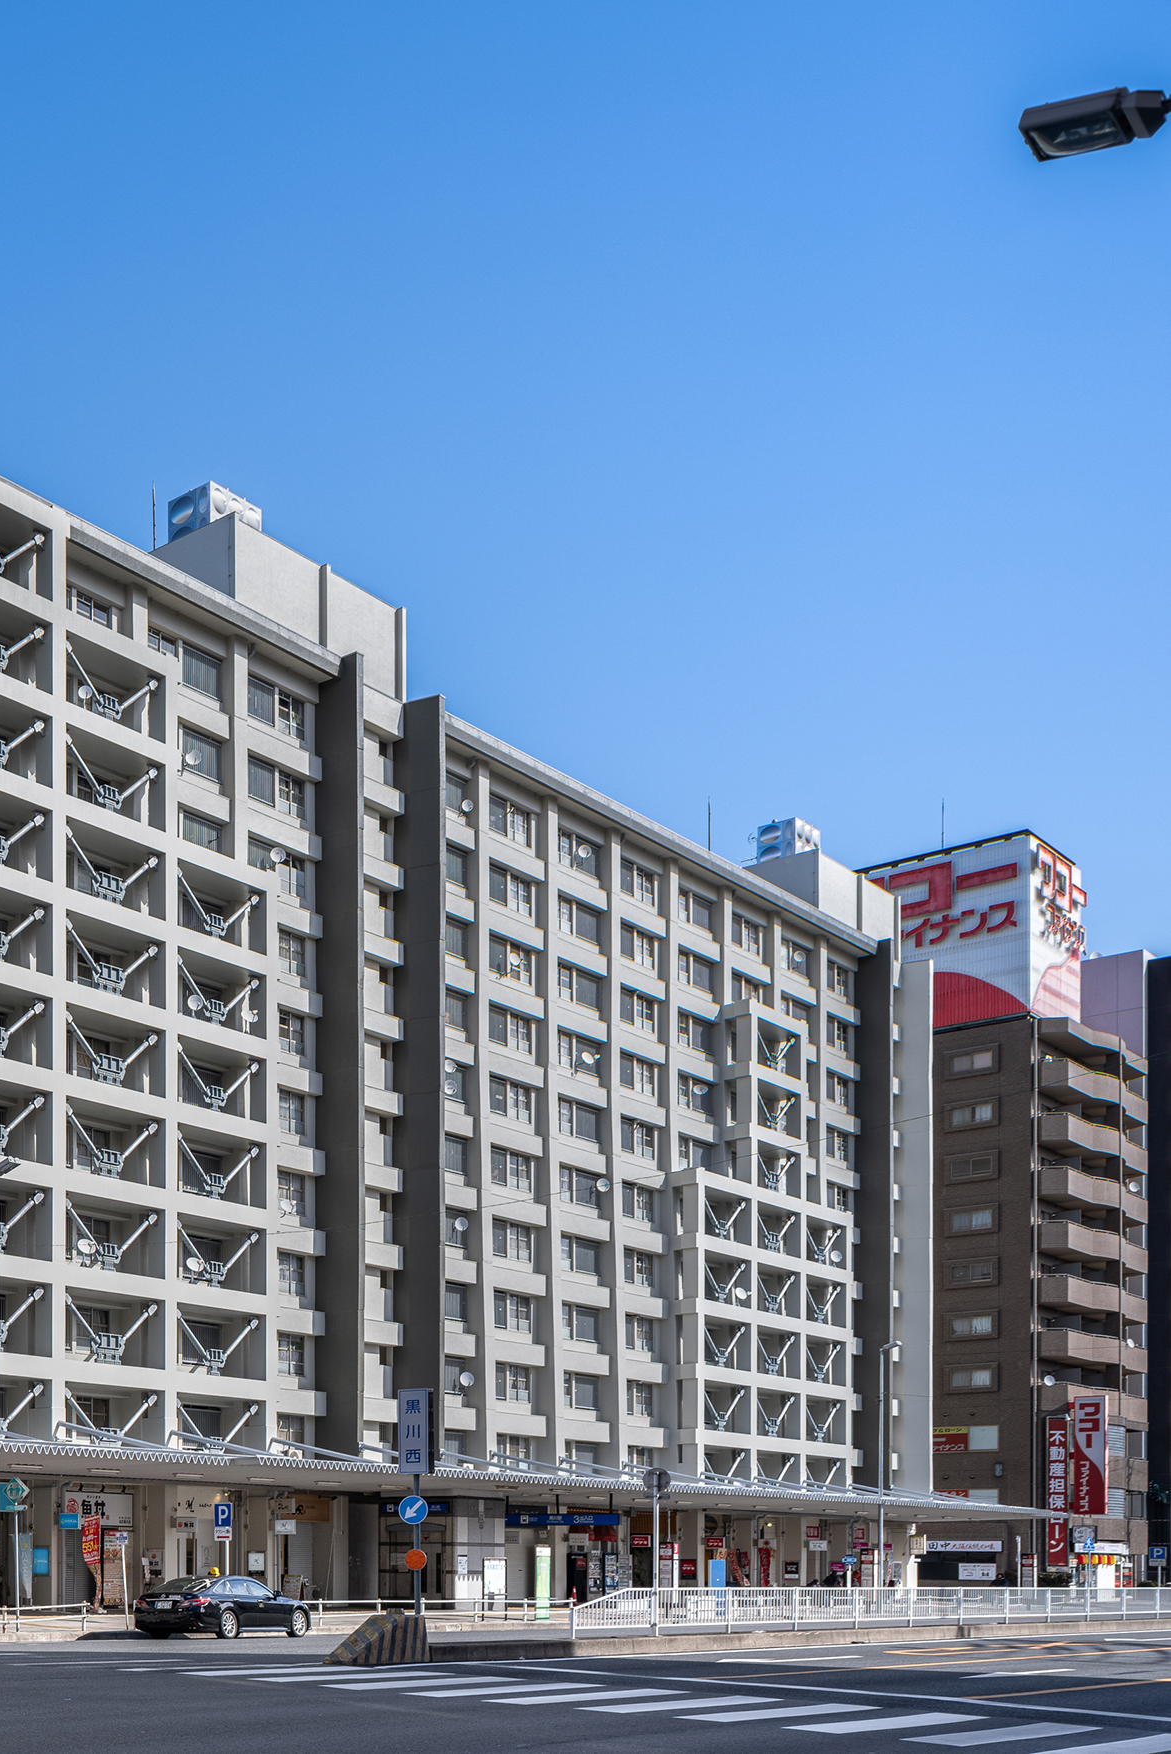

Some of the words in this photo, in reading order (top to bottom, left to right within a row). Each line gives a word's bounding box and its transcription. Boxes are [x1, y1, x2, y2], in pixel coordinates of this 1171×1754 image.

[901, 900, 1018, 949] イナンス
[405, 1399, 421, 1464] 黒川西
[1078, 1402, 1101, 1449] ワコー
[1049, 1430, 1066, 1553] 不動産担保ローン
[1079, 1461, 1090, 1512] ファイナンス
[218, 1505, 229, 1525] P
[573, 1515, 580, 1524] 3
[928, 1541, 950, 1550] 田中
[1153, 1548, 1163, 1558] P
